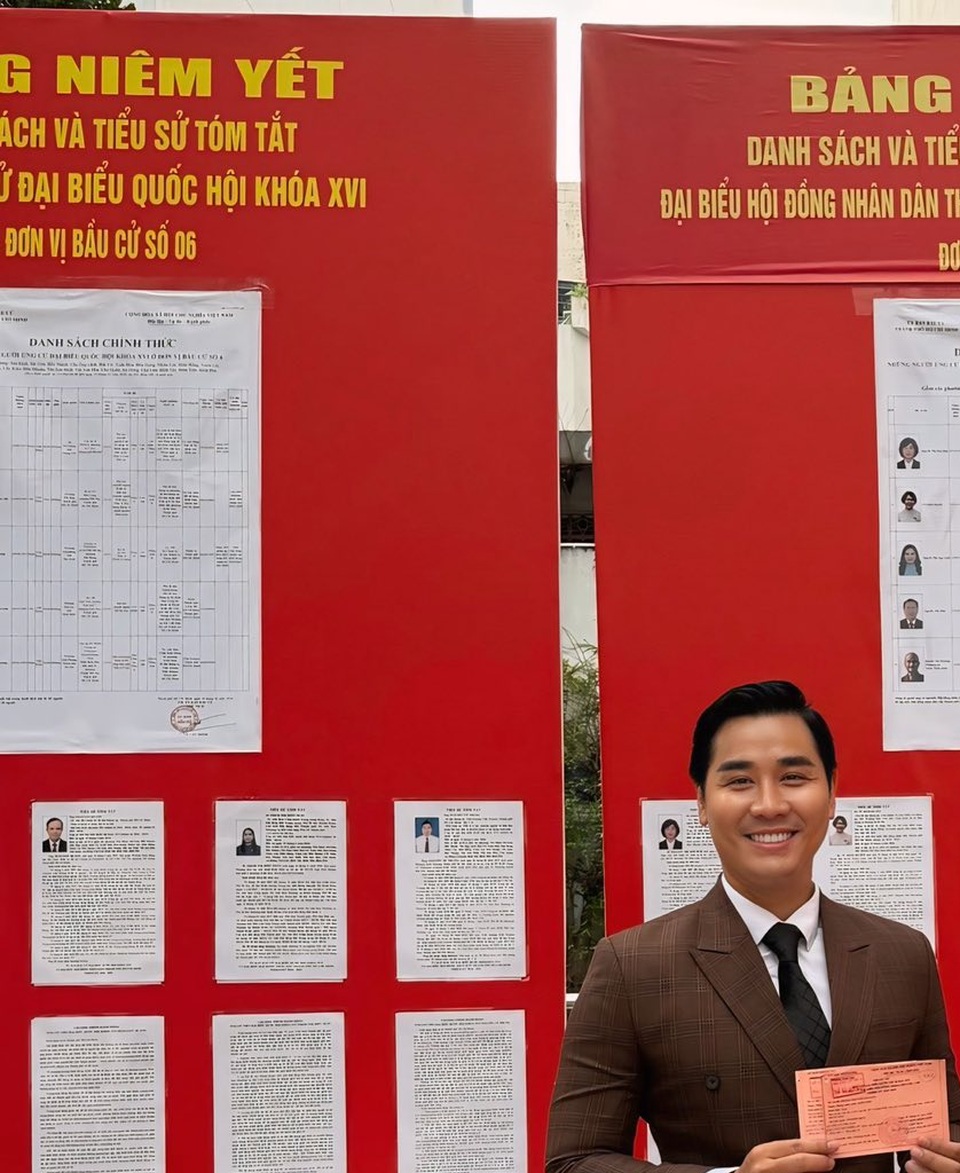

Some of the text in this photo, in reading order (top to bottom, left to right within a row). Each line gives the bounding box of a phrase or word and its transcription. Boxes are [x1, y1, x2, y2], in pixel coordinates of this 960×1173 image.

[57, 50, 211, 96] NIÊM
[235, 47, 344, 99] YẾT
[790, 66, 952, 113] BẢNG
[54, 112, 85, 148] VÀ
[93, 107, 145, 150] TIỂU
[155, 110, 189, 150] SỬ
[195, 115, 246, 151] TÓM
[255, 111, 297, 152] TẮT
[747, 136, 810, 165] DANH
[819, 130, 880, 166] SÁCH
[888, 129, 918, 165] VÀ
[18, 172, 59, 209] ĐẠI
[68, 161, 123, 204] BIỂU
[133, 164, 197, 208] QUỐC
[207, 169, 246, 212] HỘI
[255, 170, 320, 207] KHÓA
[328, 178, 366, 208] XVI
[660, 189, 692, 225] ĐẠI
[699, 177, 741, 219] BIỂU
[747, 182, 778, 225] HỘI
[784, 179, 836, 218] ĐỒNG
[842, 182, 894, 218] NHÂN
[900, 182, 939, 218] DÂN
[5, 219, 196, 264] ĐƠN VỊ BẦU CỬ SỐ 06
[29, 336, 177, 348] DANH SÁCH CHÍNH THỨC
